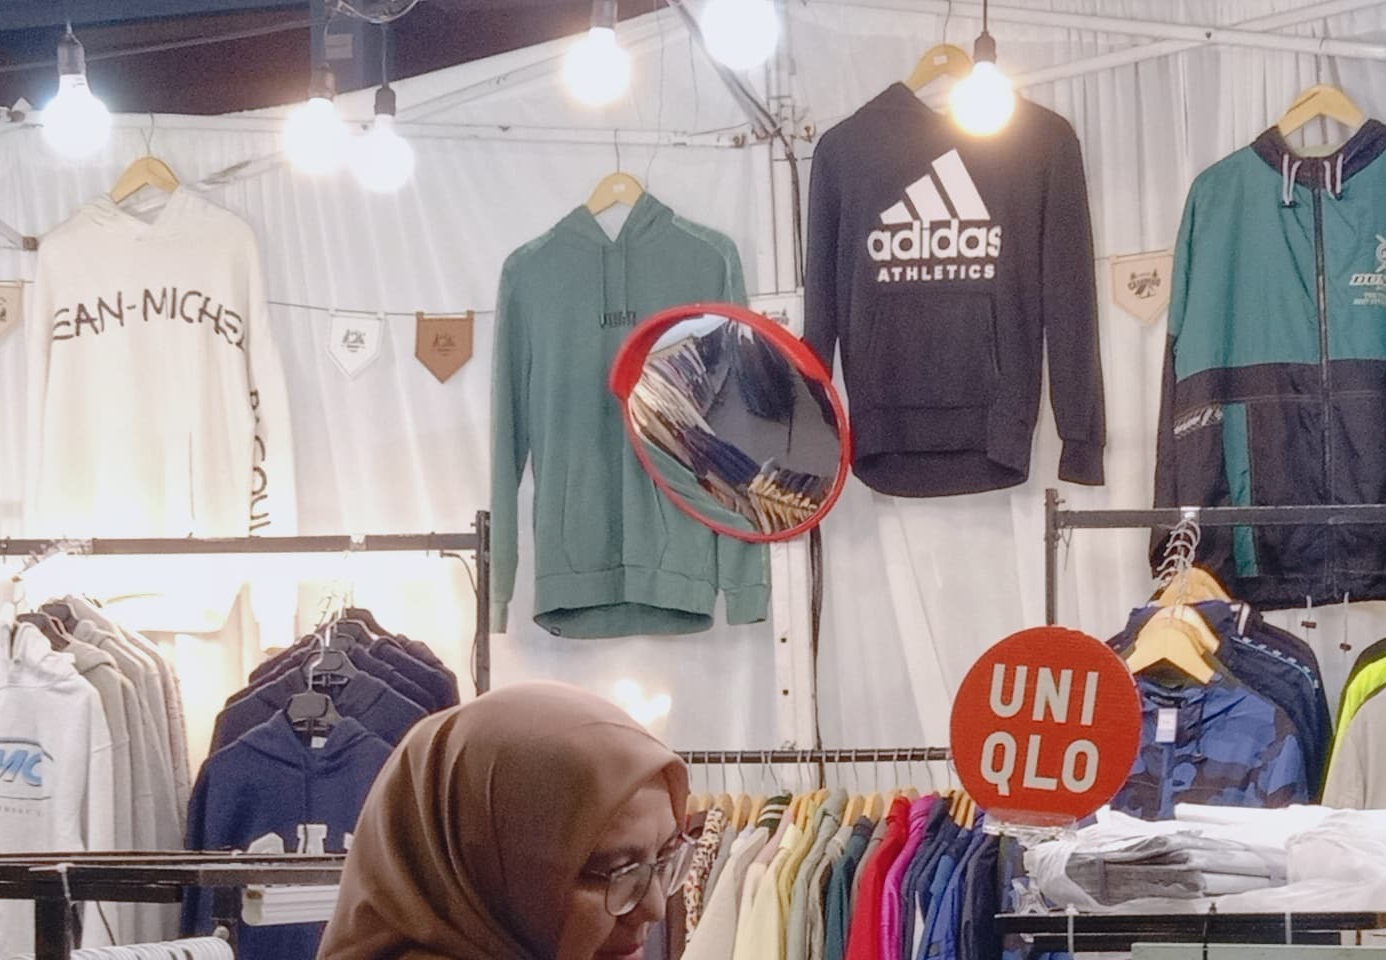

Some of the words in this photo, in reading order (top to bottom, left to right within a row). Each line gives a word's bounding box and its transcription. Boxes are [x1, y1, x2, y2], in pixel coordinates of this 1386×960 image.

[867, 218, 1002, 261] adidas
[877, 264, 996, 282] ATHLETICS
[989, 663, 1099, 726] UNI
[980, 731, 1099, 796] QLO
